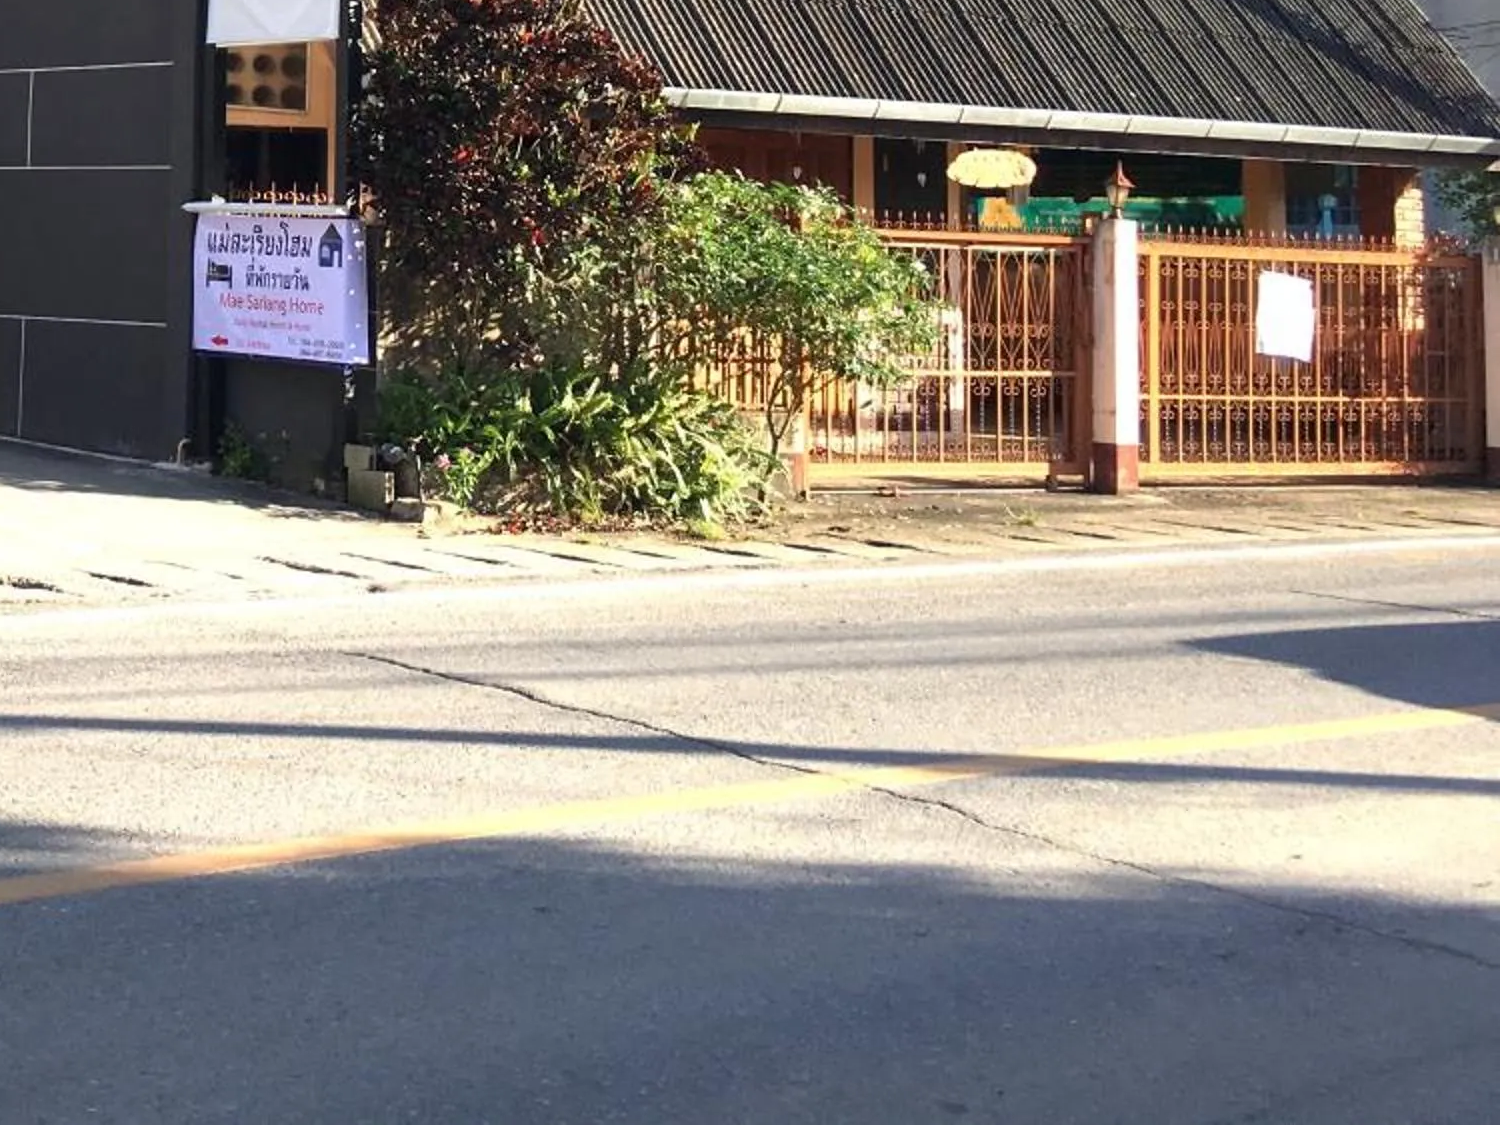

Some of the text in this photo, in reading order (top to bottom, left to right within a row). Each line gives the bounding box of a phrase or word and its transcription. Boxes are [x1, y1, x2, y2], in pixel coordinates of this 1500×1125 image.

[245, 257, 311, 291] ที่พักรายวัน
[219, 292, 325, 316] Mae Sariang Home
